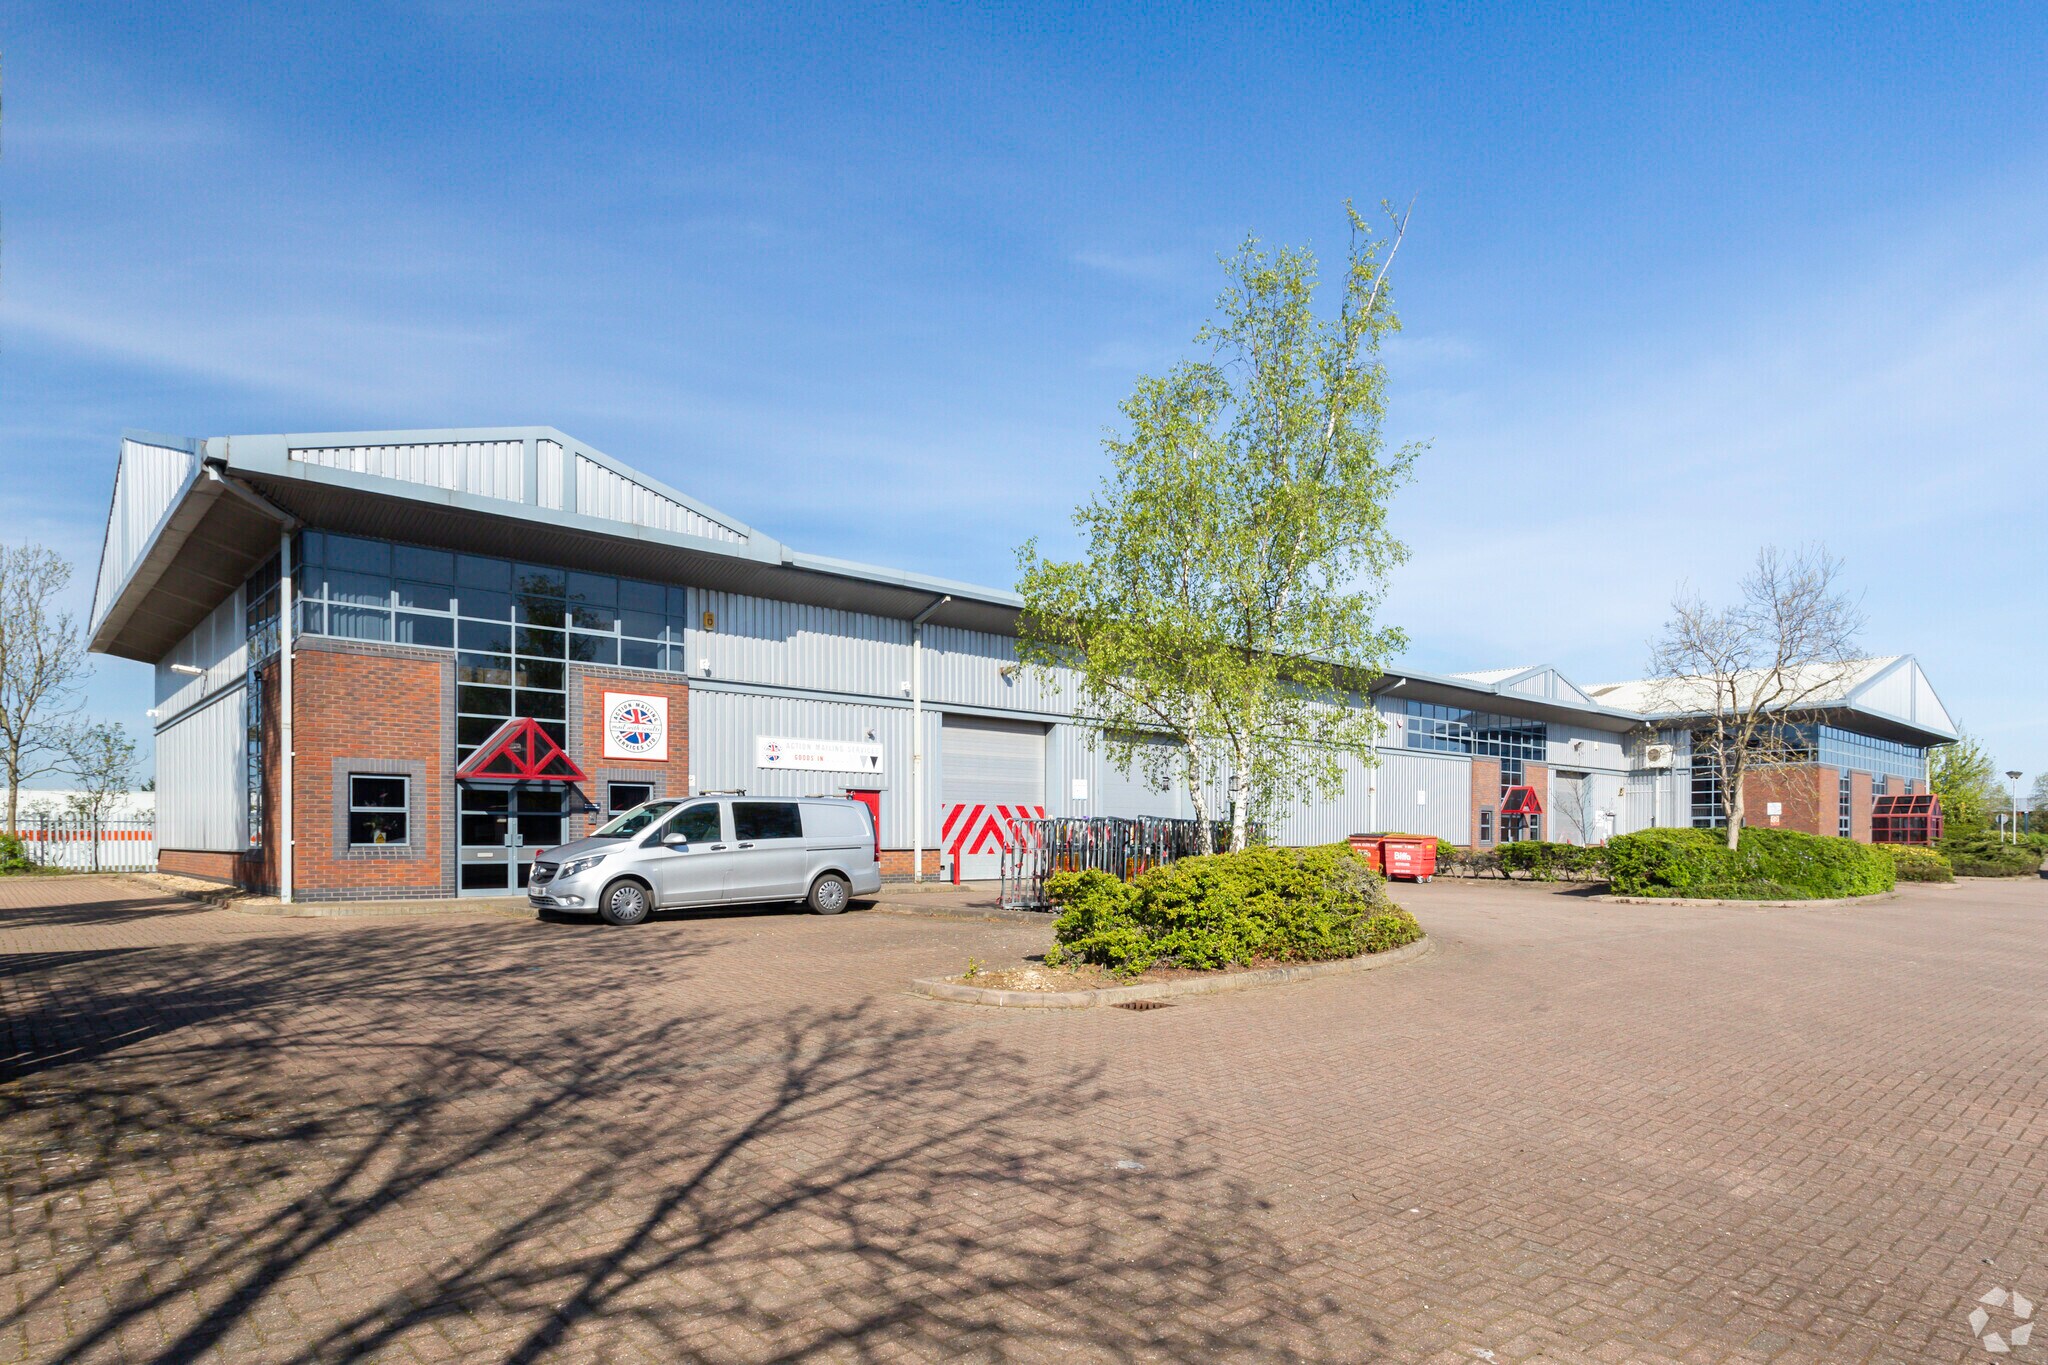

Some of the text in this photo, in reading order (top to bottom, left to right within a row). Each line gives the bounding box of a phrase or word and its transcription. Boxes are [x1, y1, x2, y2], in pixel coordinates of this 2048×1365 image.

[613, 703, 658, 721] ACTION MAILING
[615, 735, 656, 750] SERVICES LTD
[785, 742, 880, 755] ACTION MAILING SERVICES
[794, 754, 814, 762] GOODS
[1394, 851, 1411, 860] Biffa
